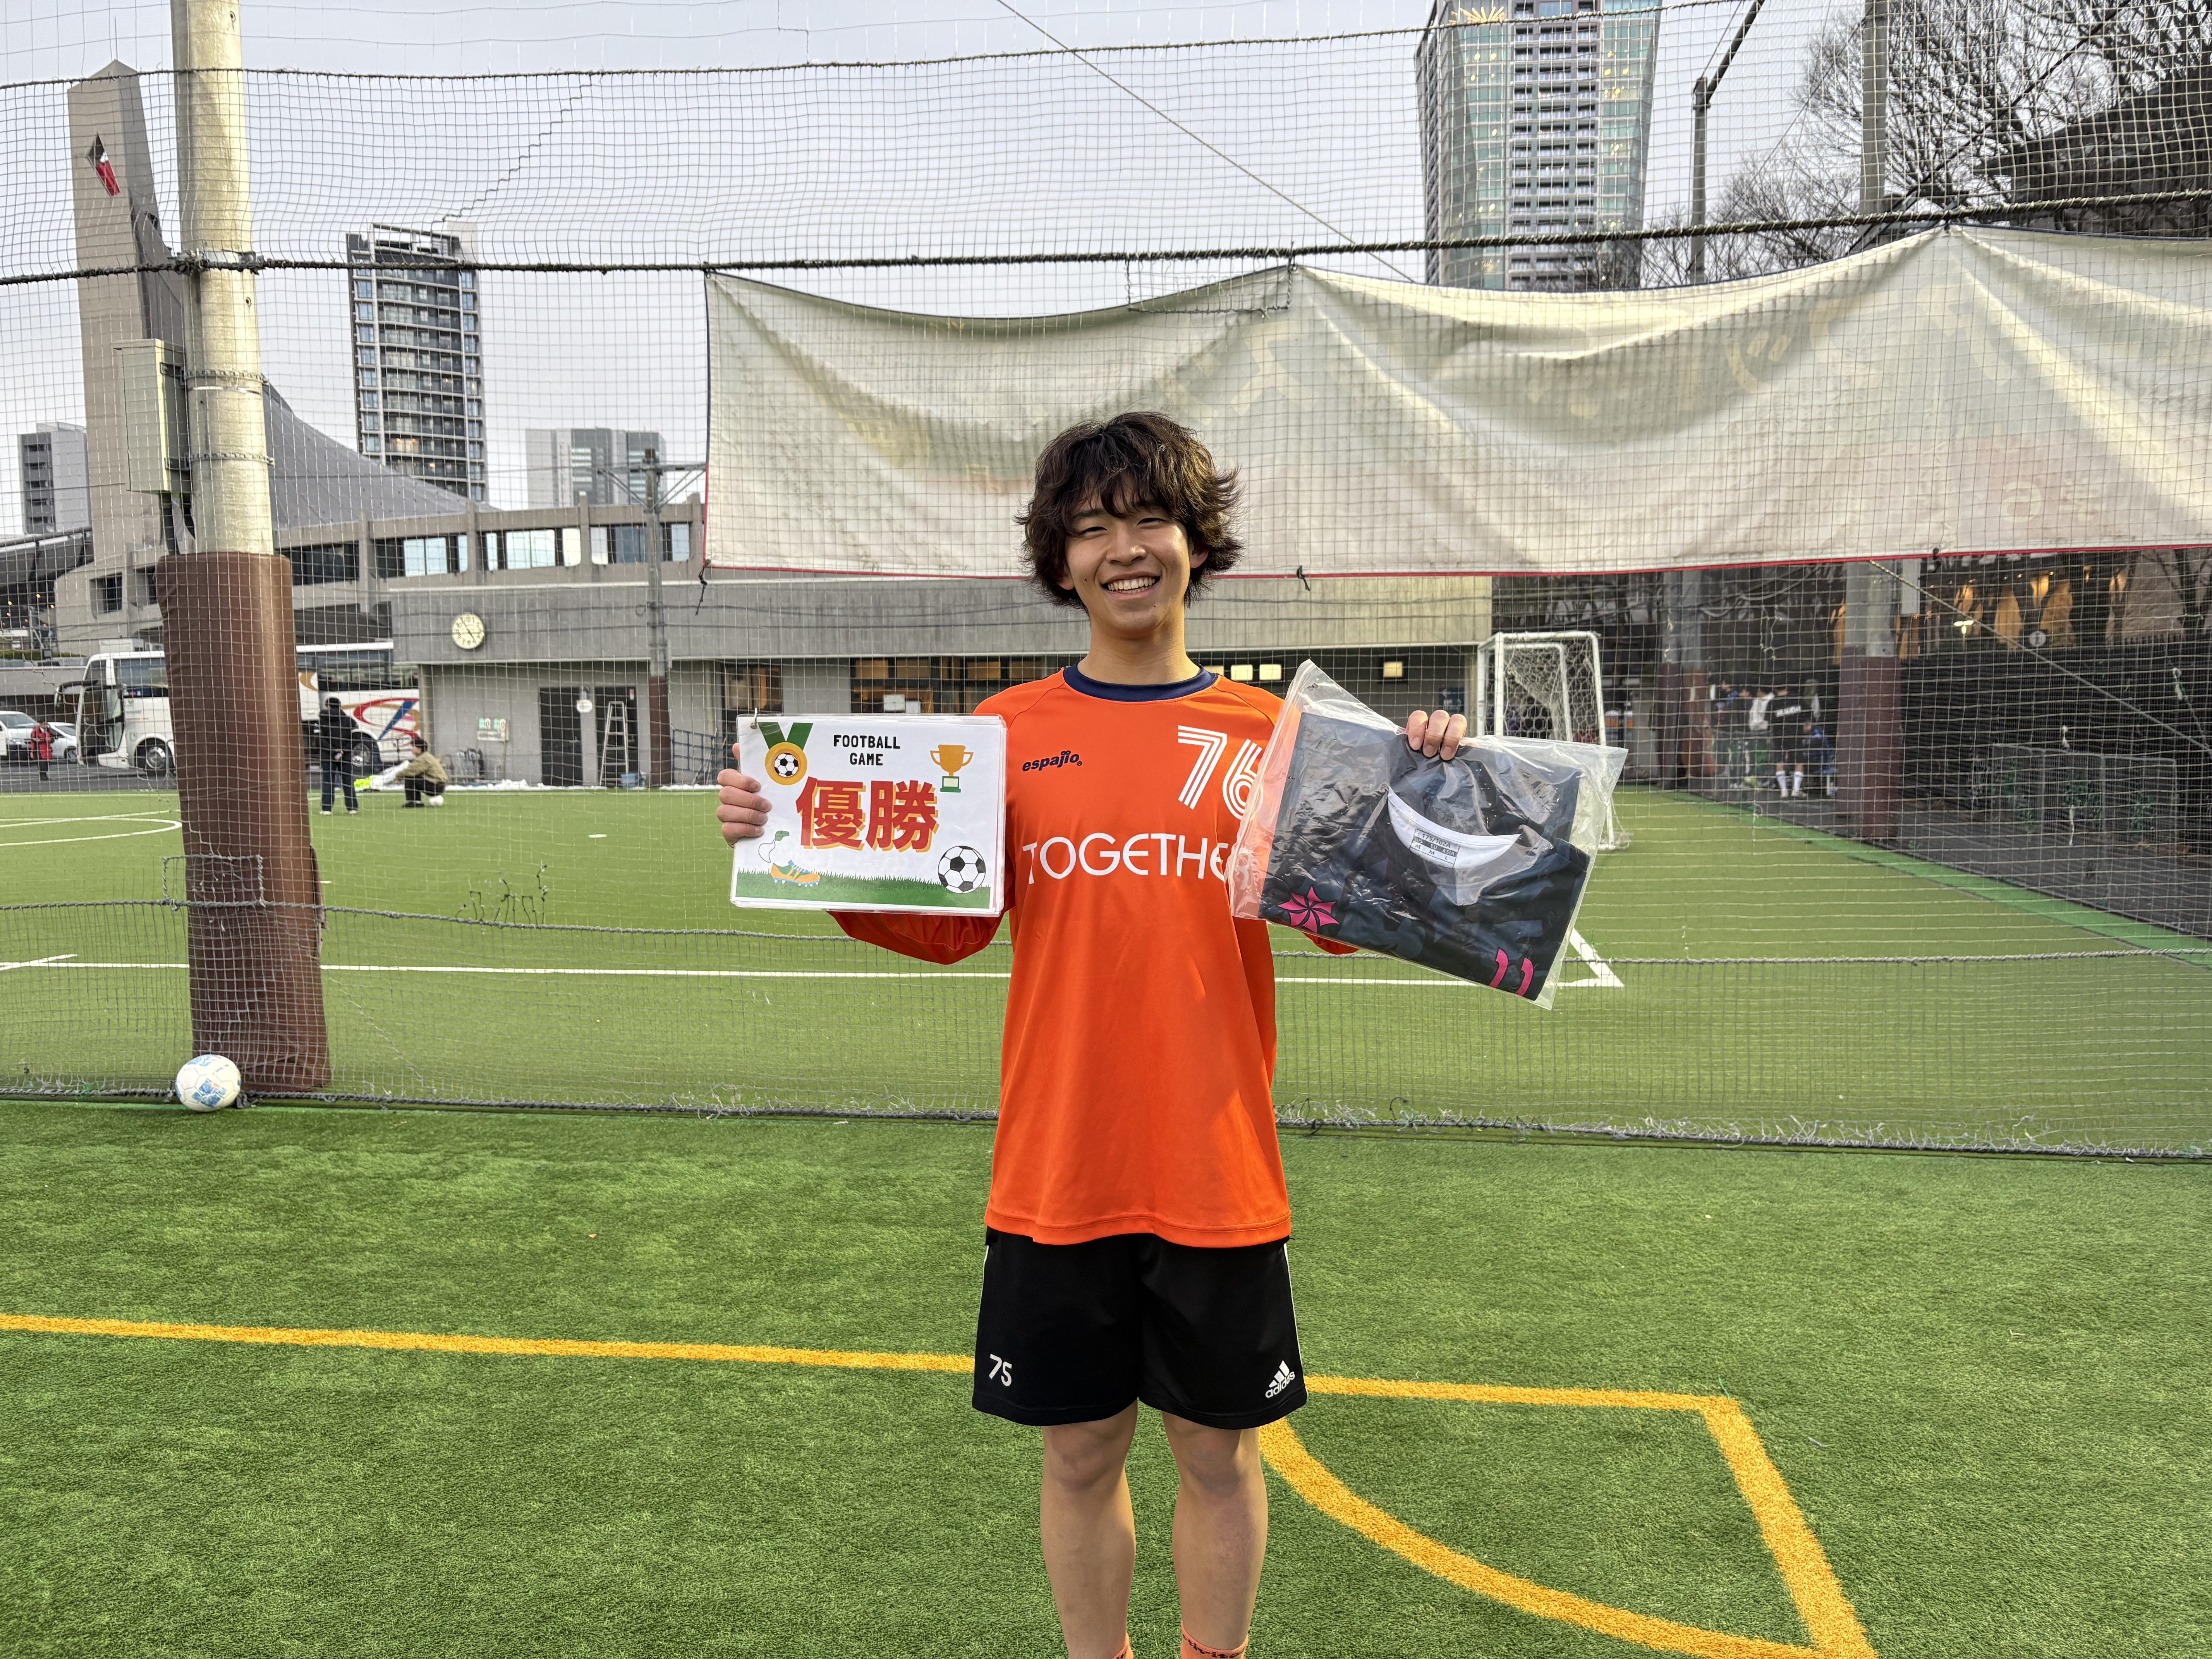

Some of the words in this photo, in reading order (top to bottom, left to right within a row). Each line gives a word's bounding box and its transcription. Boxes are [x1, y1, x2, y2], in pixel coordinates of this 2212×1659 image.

[833, 735, 900, 749] FOOTBALL
[850, 752, 883, 766] GAME
[1178, 725, 1263, 821] 76
[795, 776, 940, 853] 優勝
[1422, 833, 1450, 848] 175/102A
[1442, 848, 1455, 856] ASIA
[989, 1353, 1012, 1386] 75
[1265, 1371, 1295, 1398] adidas
